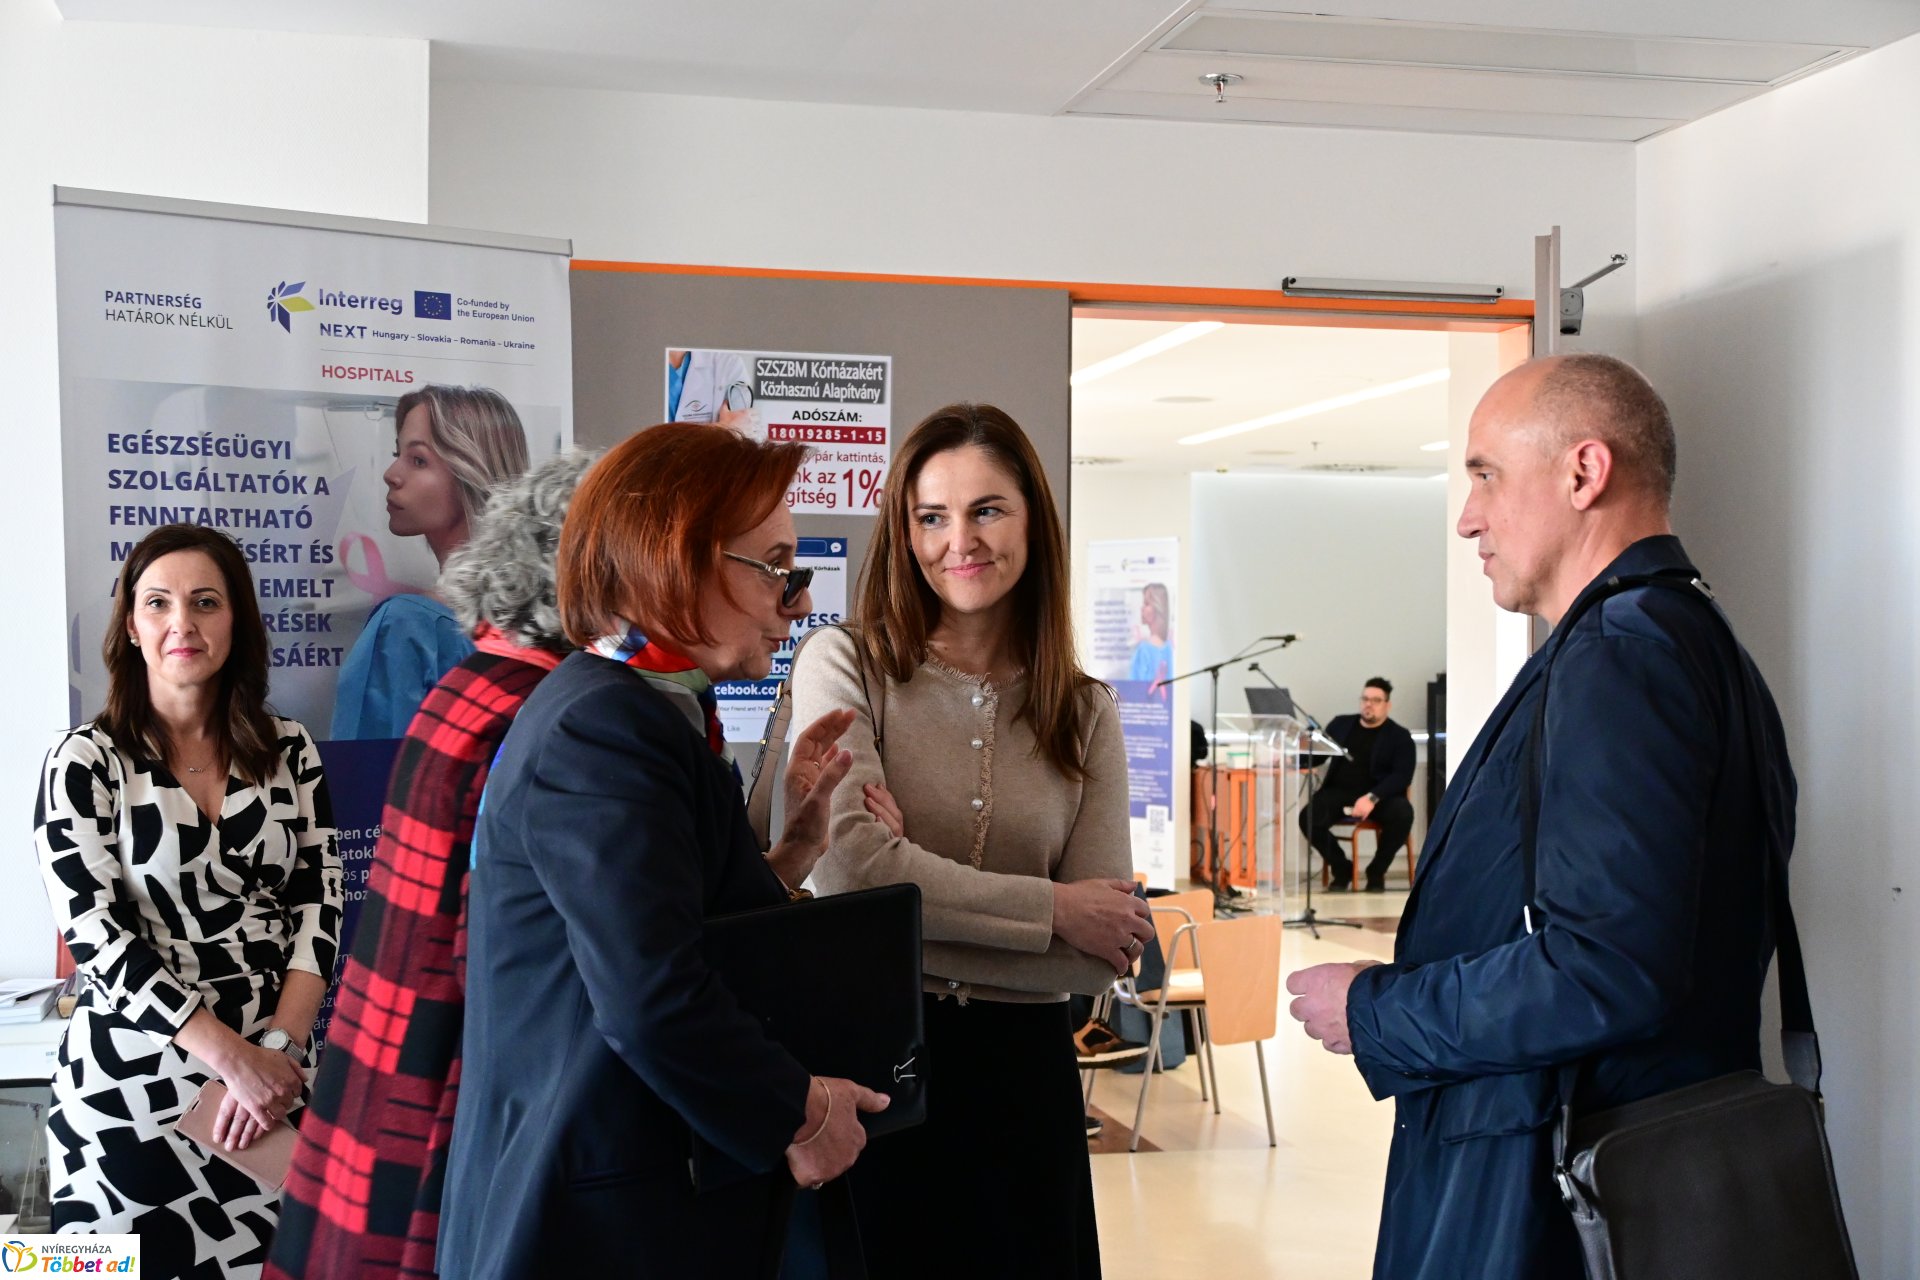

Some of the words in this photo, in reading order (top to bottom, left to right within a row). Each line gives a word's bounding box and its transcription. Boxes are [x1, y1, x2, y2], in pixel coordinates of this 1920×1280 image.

[104, 290, 202, 309] PARTNERSÉG
[319, 288, 403, 315] Interreg
[457, 297, 498, 309] Co-funded
[500, 301, 510, 311] by
[105, 308, 175, 326] HATÁROK
[179, 312, 233, 330] NÉLKÜL
[457, 308, 469, 318] the
[472, 309, 509, 321] European
[511, 314, 535, 323] Union
[320, 322, 367, 340] NEXT
[372, 330, 409, 342] Hungary
[417, 334, 451, 344] Slovakia
[460, 337, 496, 347] Romania
[503, 341, 535, 350] Ukraine
[322, 364, 414, 384] HOSPITALS
[756, 359, 808, 378] SZSZBM
[811, 361, 883, 381] Kórházakért
[760, 380, 820, 399] Közhasznú
[822, 382, 881, 404] Alapítvány
[792, 408, 862, 422] ADÓSZÁM:
[107, 429, 291, 460] EGÉSZSÉGÜGYI
[815, 450, 833, 464] pár
[836, 451, 886, 465] kattintás,
[108, 466, 308, 495] SZOLGÁLTATÓK
[313, 476, 330, 496] A
[817, 472, 837, 484] az
[842, 467, 884, 509] 1%
[784, 487, 837, 509] gítség
[109, 504, 313, 530] FENNTARTHATÓ
[309, 539, 334, 564] ÉS
